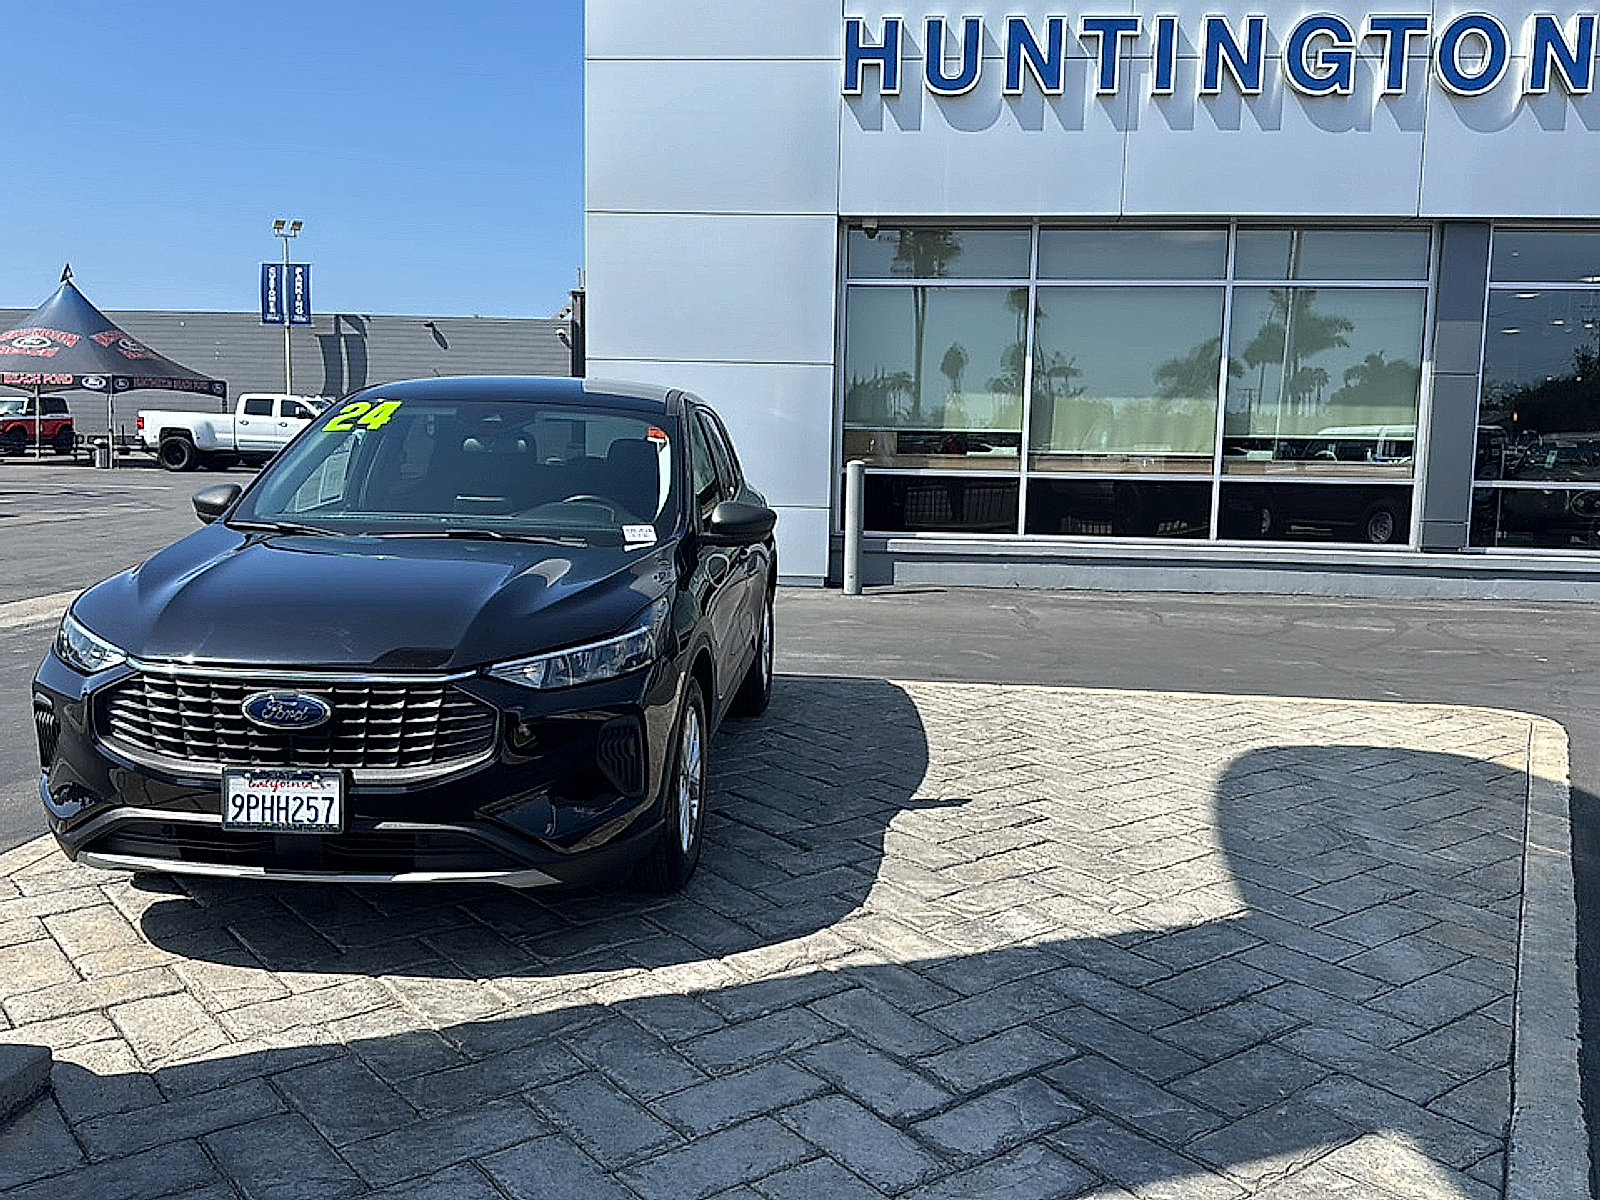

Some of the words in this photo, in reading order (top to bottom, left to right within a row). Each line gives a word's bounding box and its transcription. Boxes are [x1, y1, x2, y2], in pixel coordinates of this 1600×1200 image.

[843, 14, 1598, 97] HUNTINGTON
[294, 266, 304, 315] PARKING
[323, 401, 402, 431] 24
[261, 698, 309, 721] Ford
[231, 794, 335, 823] 9PHH257
